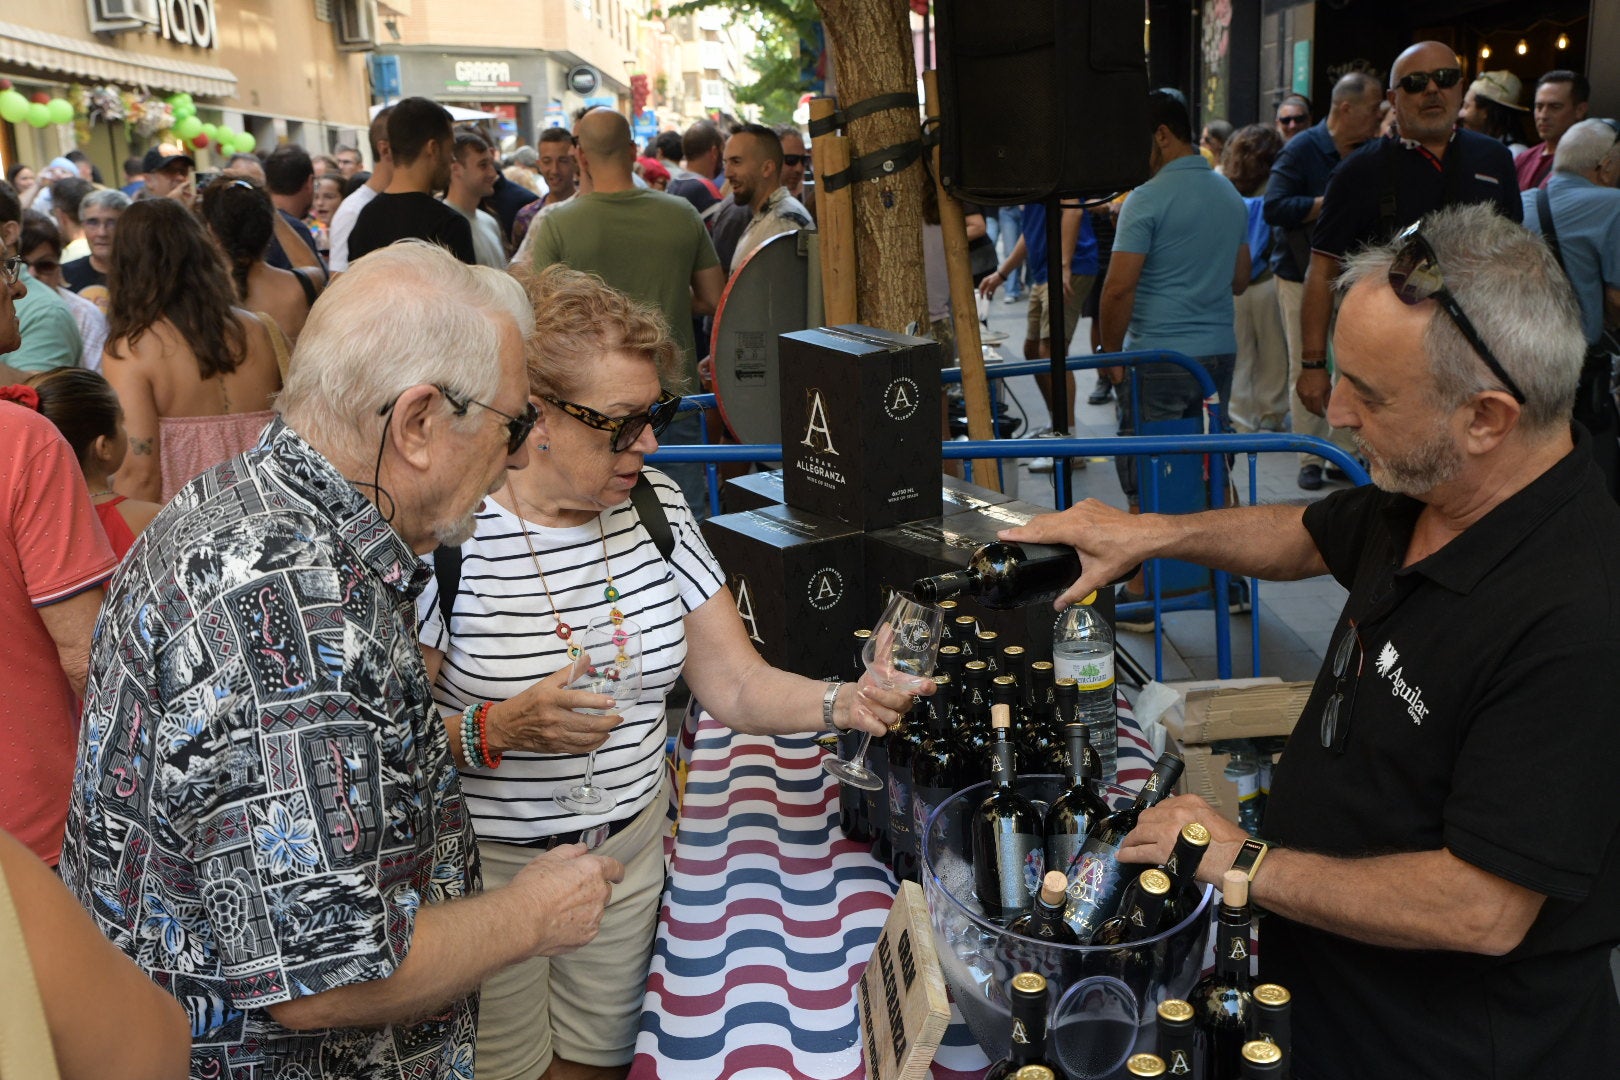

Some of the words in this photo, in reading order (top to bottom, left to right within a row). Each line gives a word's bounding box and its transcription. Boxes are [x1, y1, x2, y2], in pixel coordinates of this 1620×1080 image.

[891, 385, 913, 410] A
[800, 388, 840, 456] A
[796, 460, 846, 485] ALLEGRANZA
[814, 575, 837, 601] A
[1388, 667, 1429, 719] Aguilar
[898, 928, 916, 994] GRAN
[1228, 937, 1249, 960] A
[878, 931, 907, 1069] ALLEGRANZA
[1011, 1018, 1031, 1044] A
[1168, 1050, 1191, 1075] A
